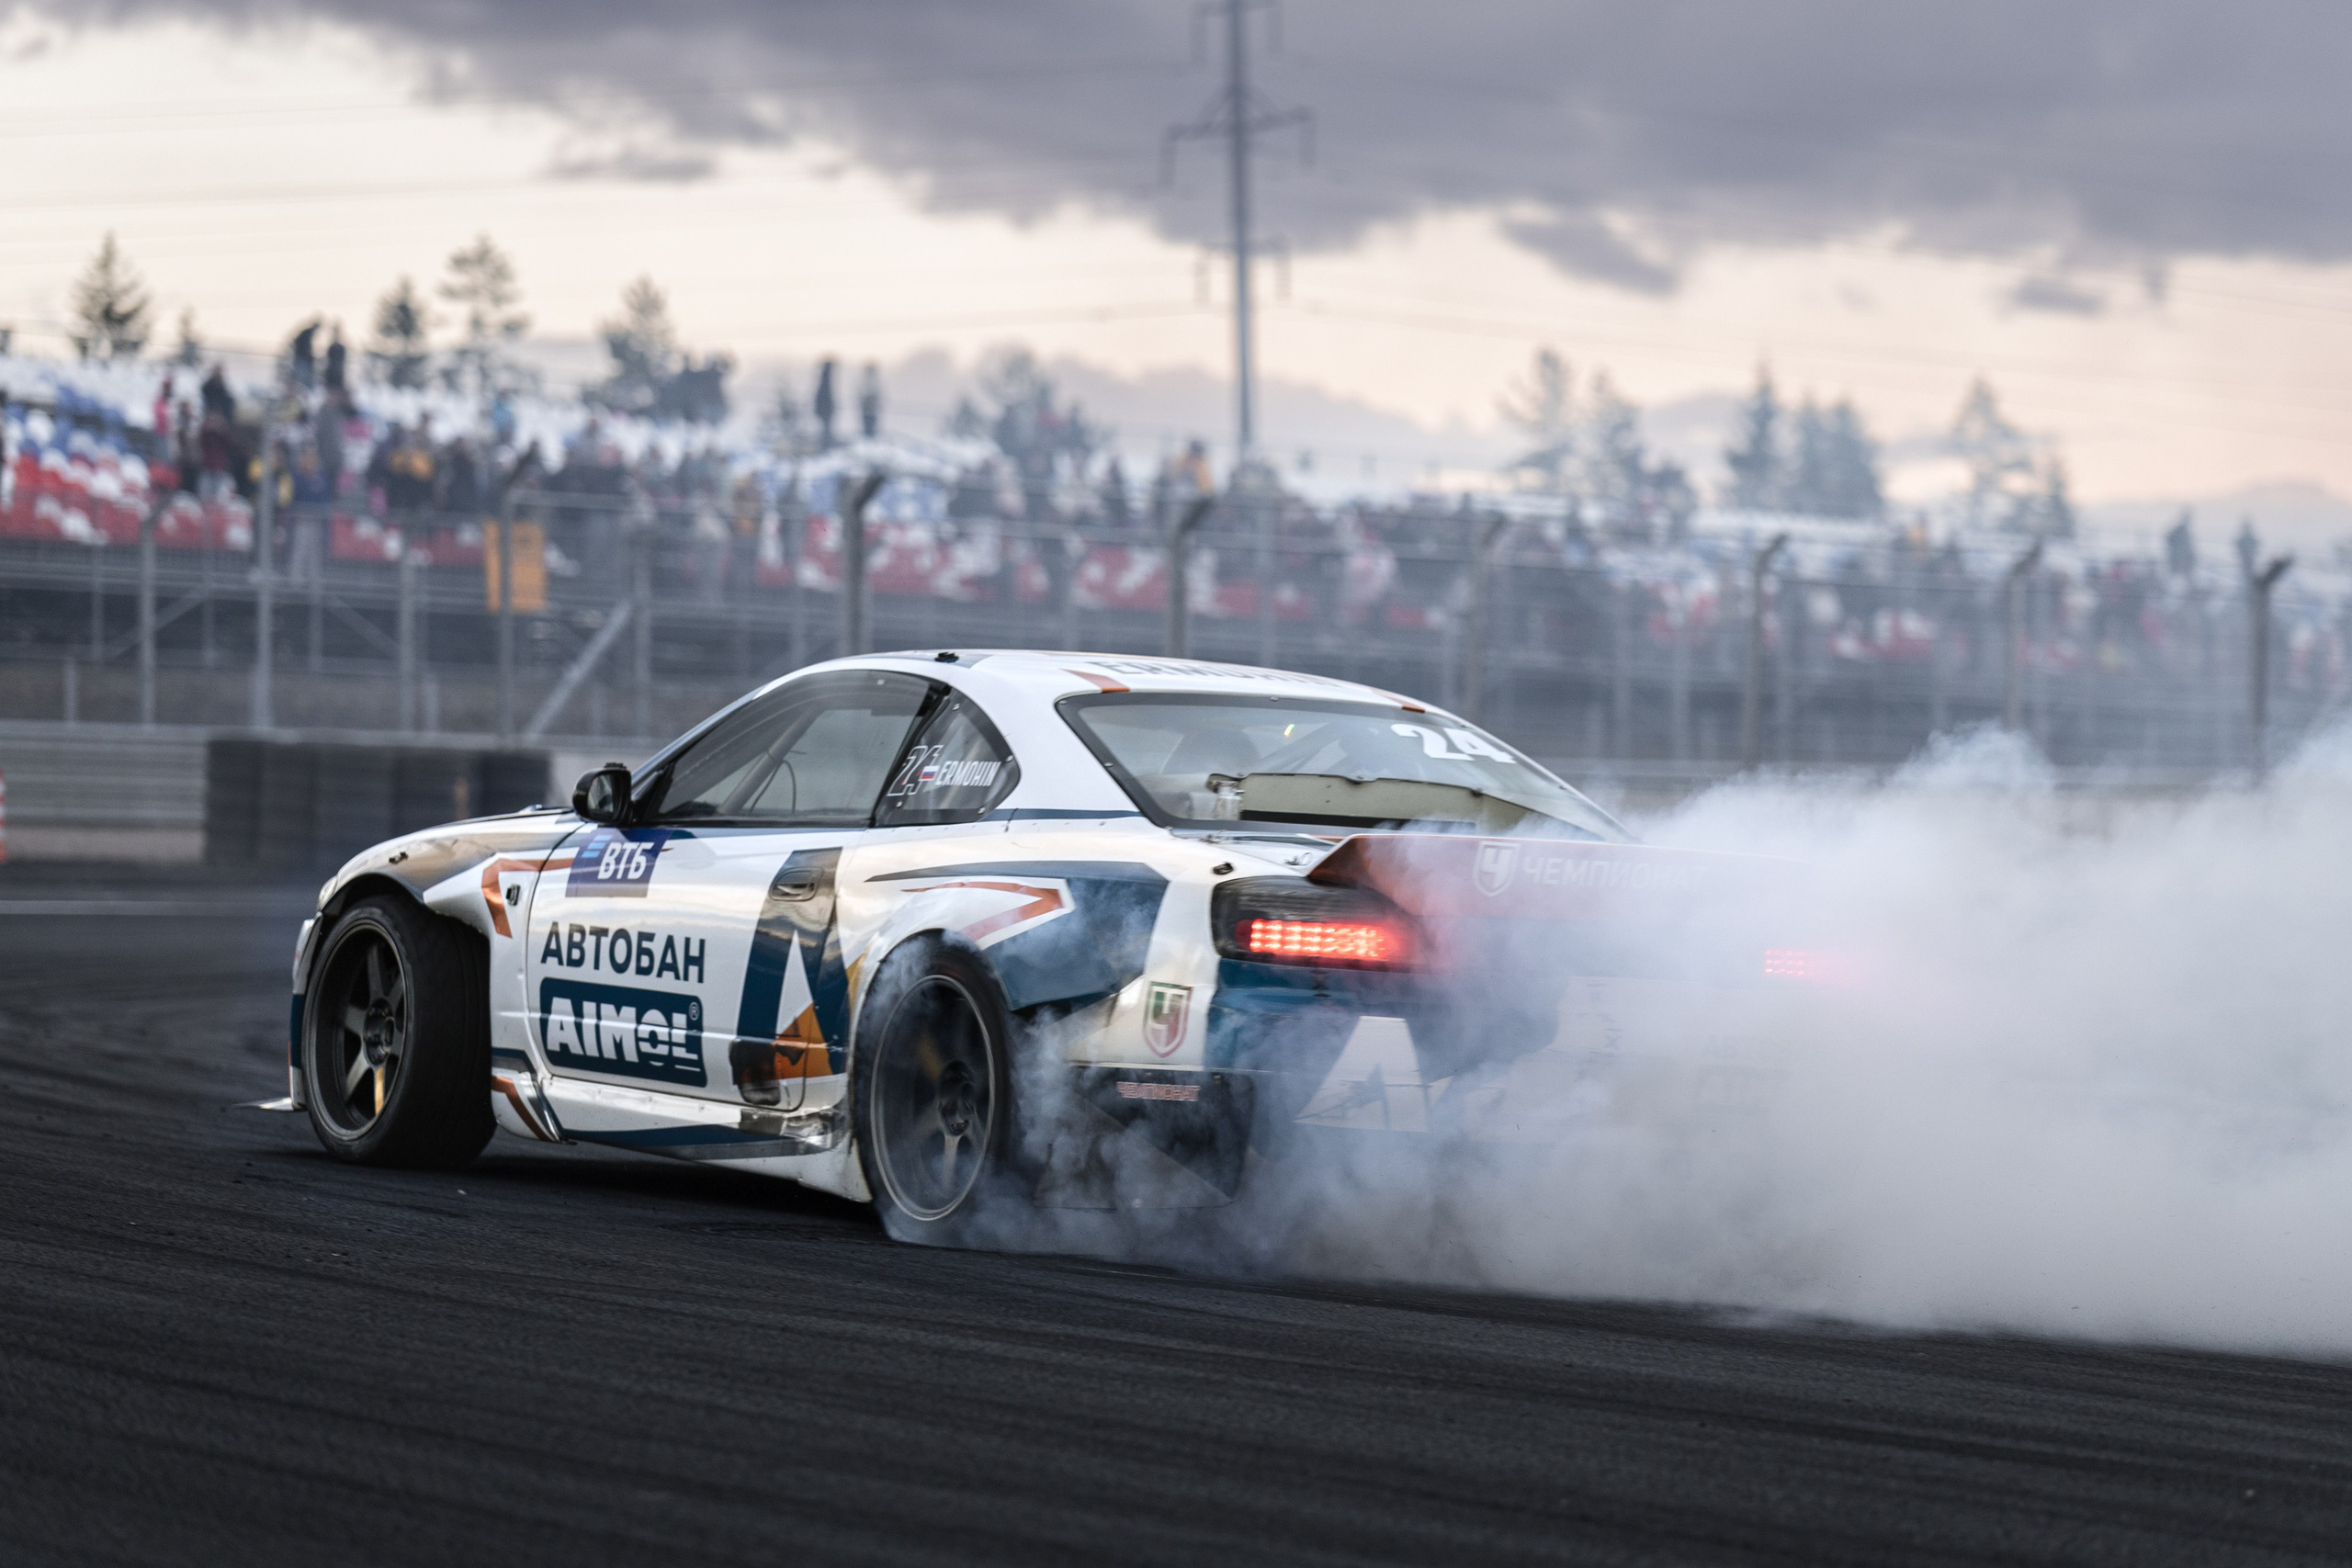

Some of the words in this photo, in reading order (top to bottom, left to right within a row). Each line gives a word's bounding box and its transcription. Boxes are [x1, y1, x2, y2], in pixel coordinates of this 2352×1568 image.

[1390, 723, 1517, 764] 24
[887, 744, 944, 796] 24
[934, 761, 1002, 787] ERMOHIN
[597, 841, 655, 881] ВТБ
[540, 920, 707, 984] АВТОБАН
